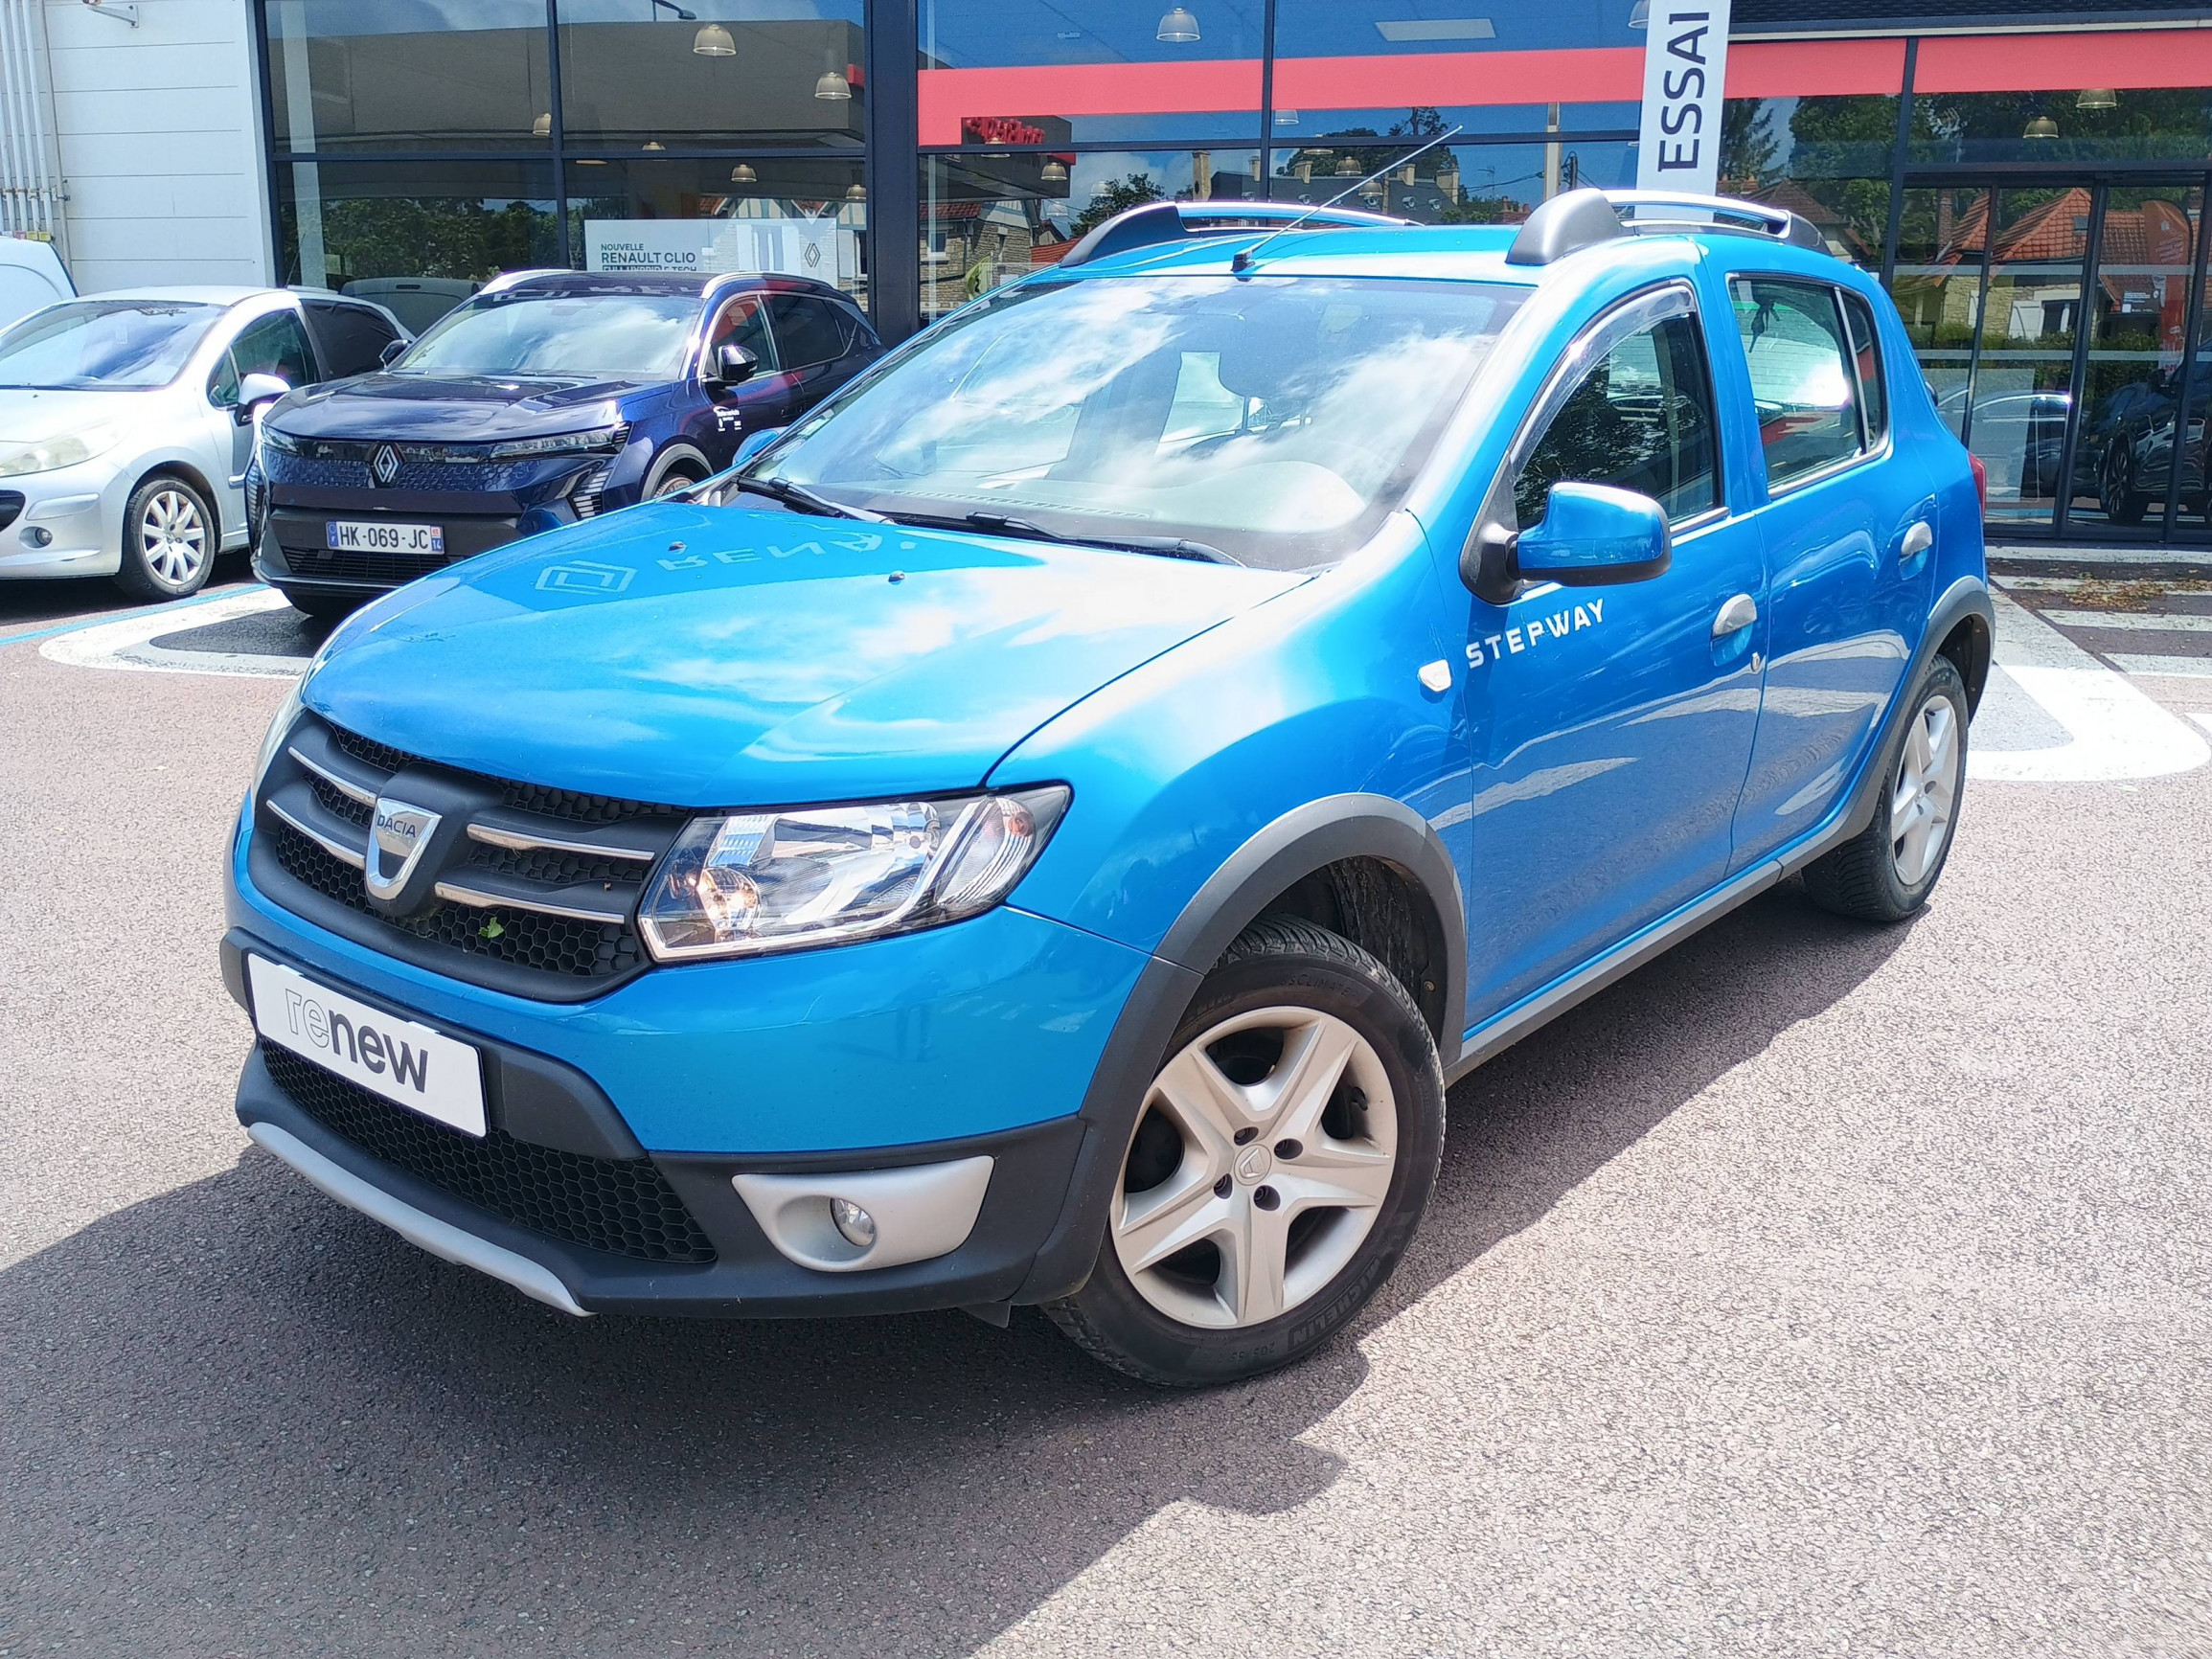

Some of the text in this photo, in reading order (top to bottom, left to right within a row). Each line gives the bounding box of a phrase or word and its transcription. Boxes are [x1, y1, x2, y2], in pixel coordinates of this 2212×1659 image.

[1657, 11, 1710, 172] ESSAI
[602, 252, 696, 263] RENAULT CLIO
[339, 526, 428, 550] HK-069-JC
[1465, 598, 1605, 670] STEPWAY
[376, 814, 416, 838] DACIA
[285, 989, 428, 1093] renew
[1293, 1258, 1380, 1346] MICHELIN
